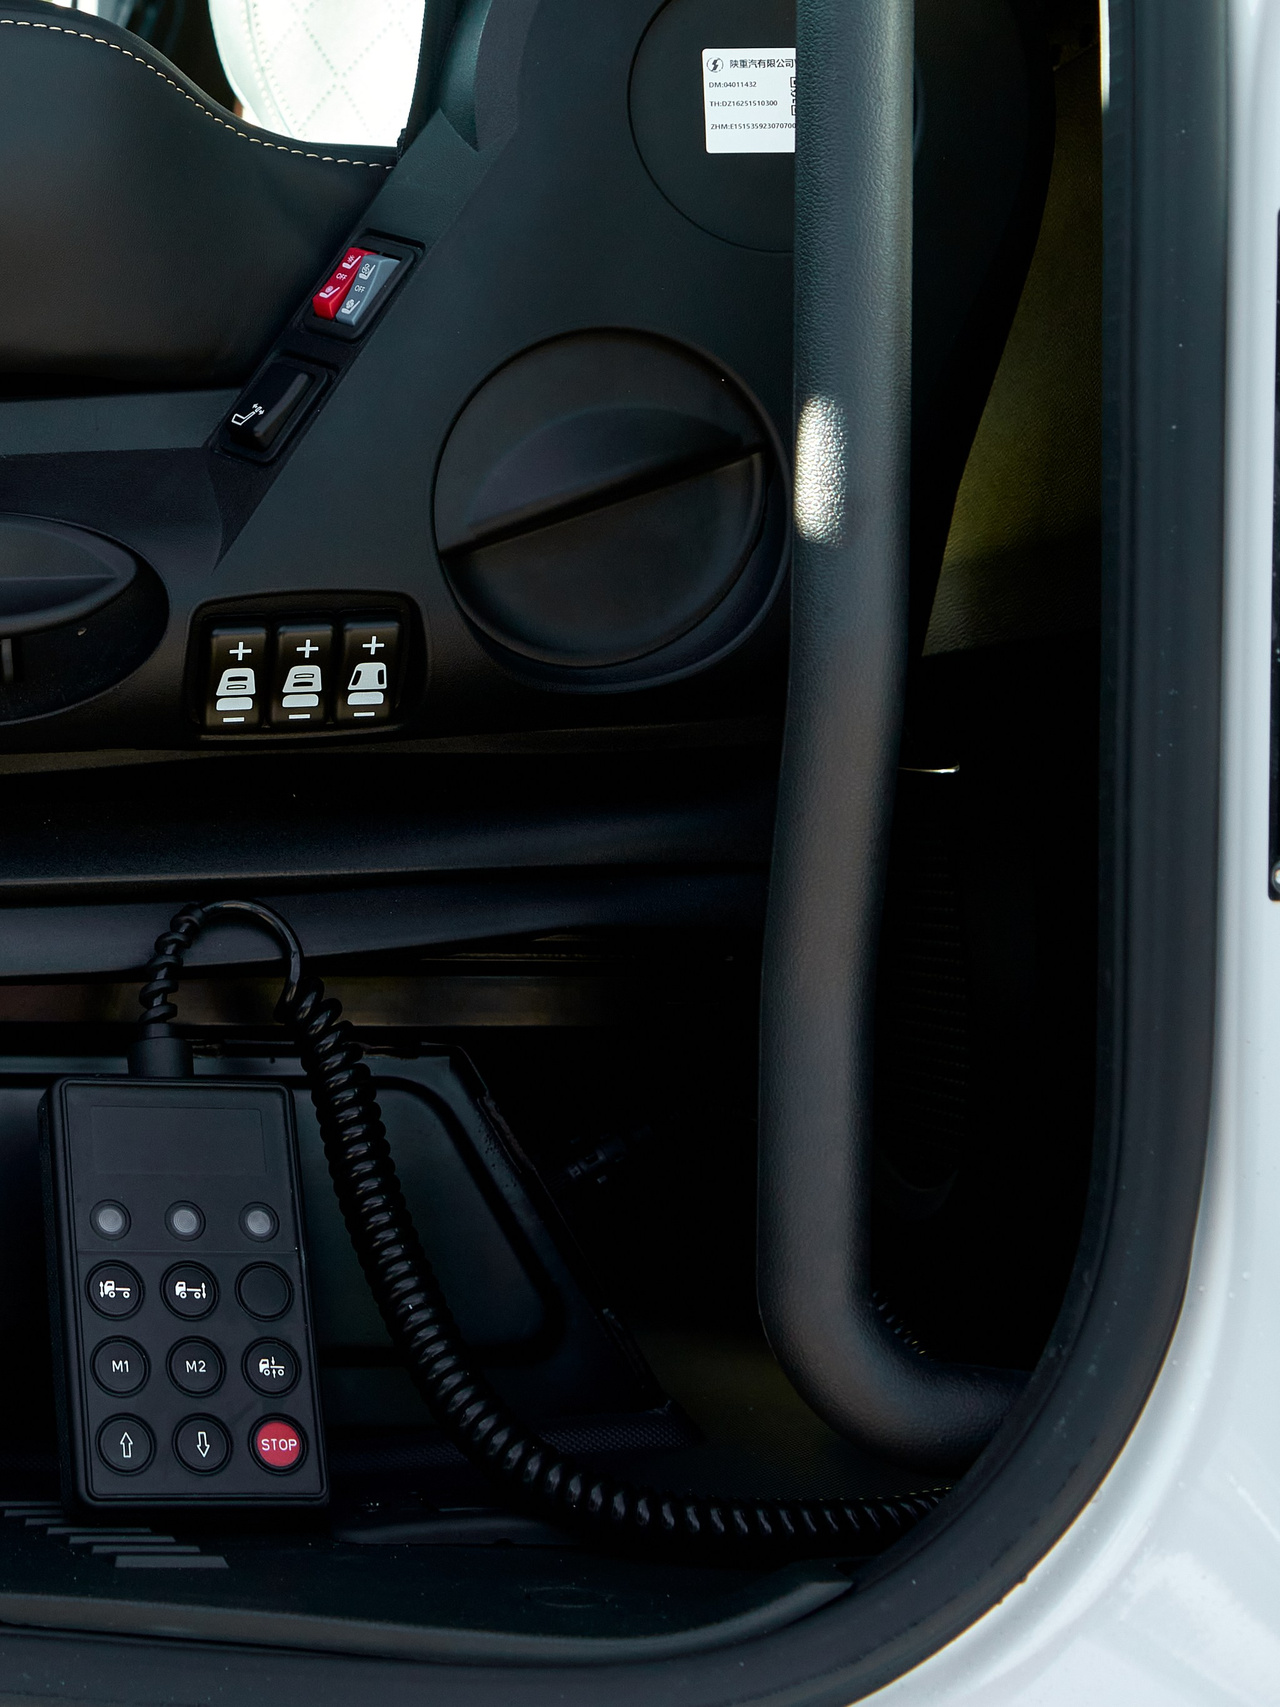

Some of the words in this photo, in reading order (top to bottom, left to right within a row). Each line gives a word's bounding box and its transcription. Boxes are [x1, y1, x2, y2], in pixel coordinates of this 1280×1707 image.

[729, 58, 796, 69] 陕重汽有限公司
[335, 272, 348, 281] OFF
[354, 284, 366, 293] OFF
[111, 1360, 129, 1373] M1
[185, 1360, 207, 1373] M2
[261, 1438, 298, 1451] STOP
